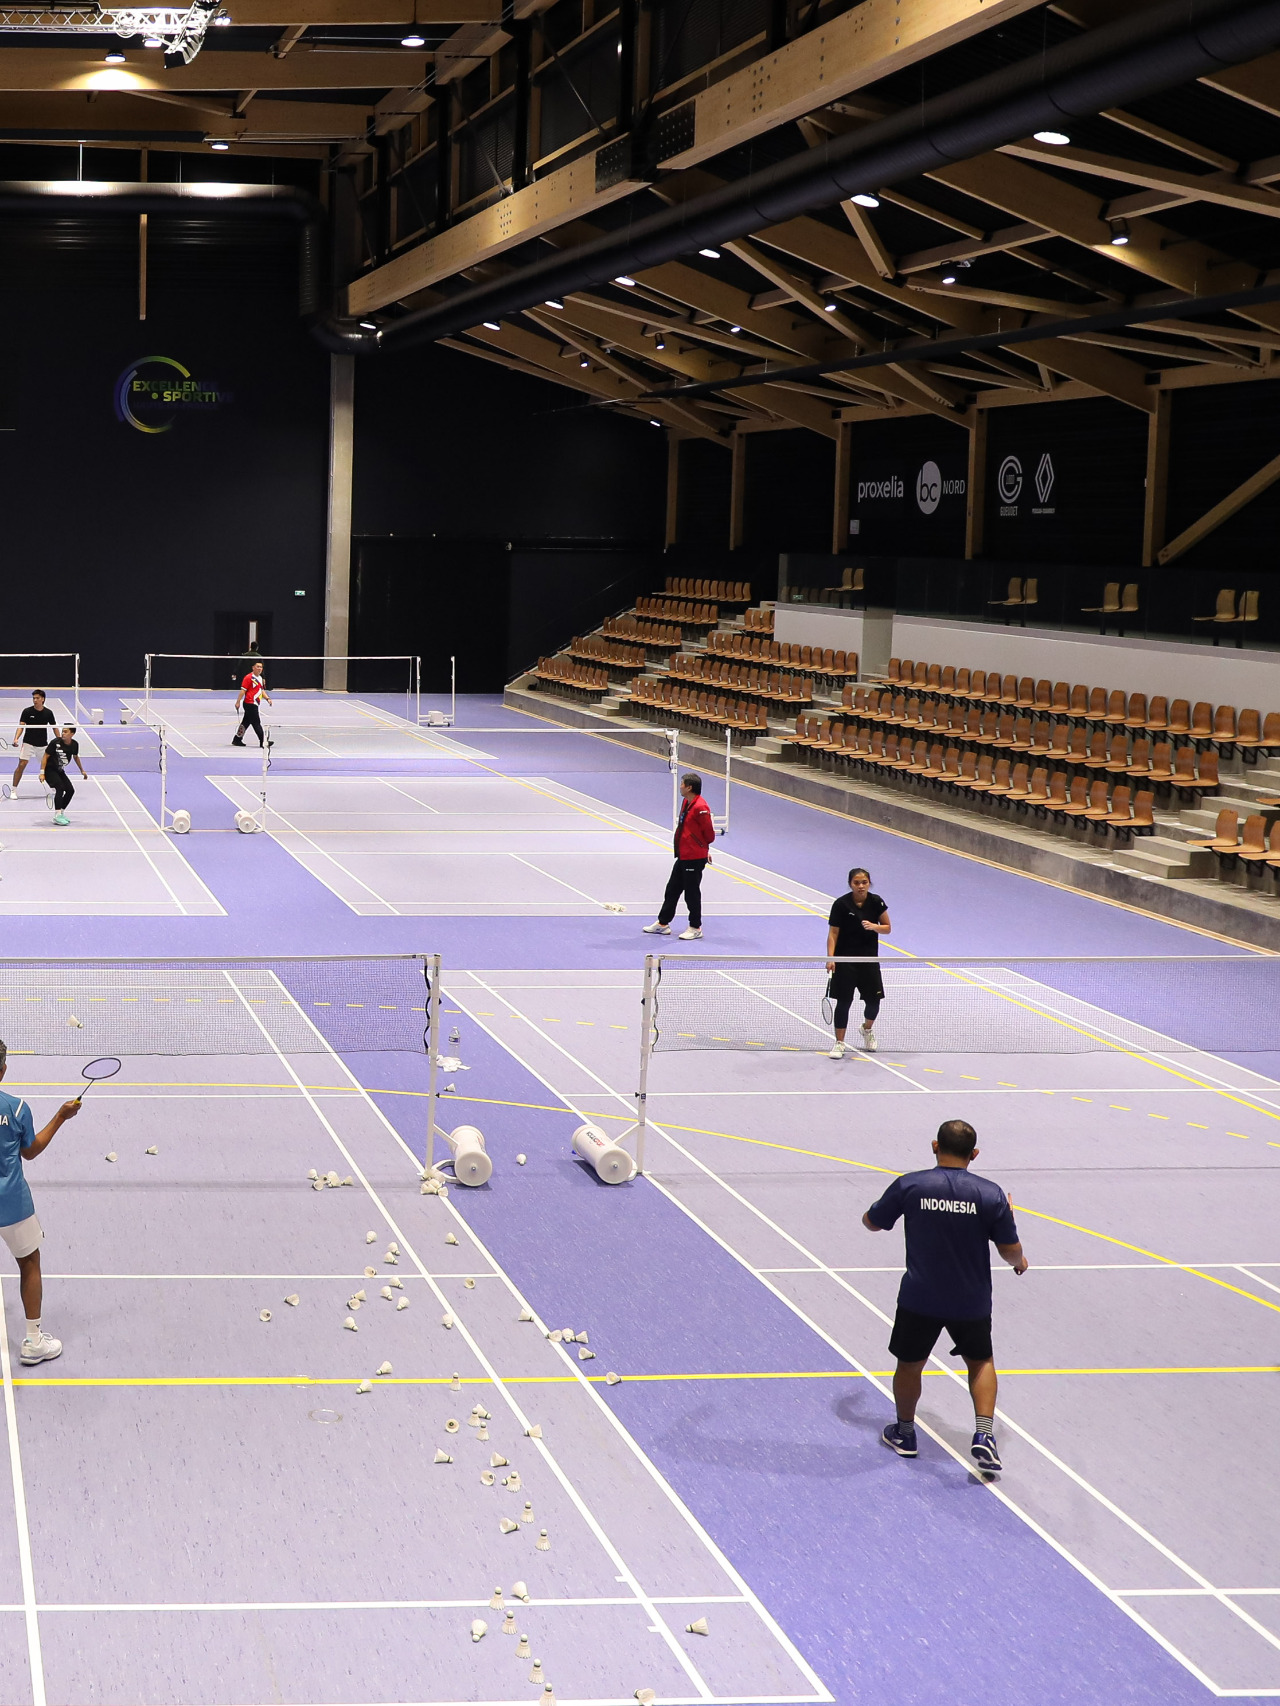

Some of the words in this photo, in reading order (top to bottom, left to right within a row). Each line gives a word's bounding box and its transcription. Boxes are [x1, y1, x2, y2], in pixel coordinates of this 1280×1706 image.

[858, 475, 904, 503] proxelia
[943, 479, 966, 494] NORD
[920, 1198, 977, 1215] INDONESIA
